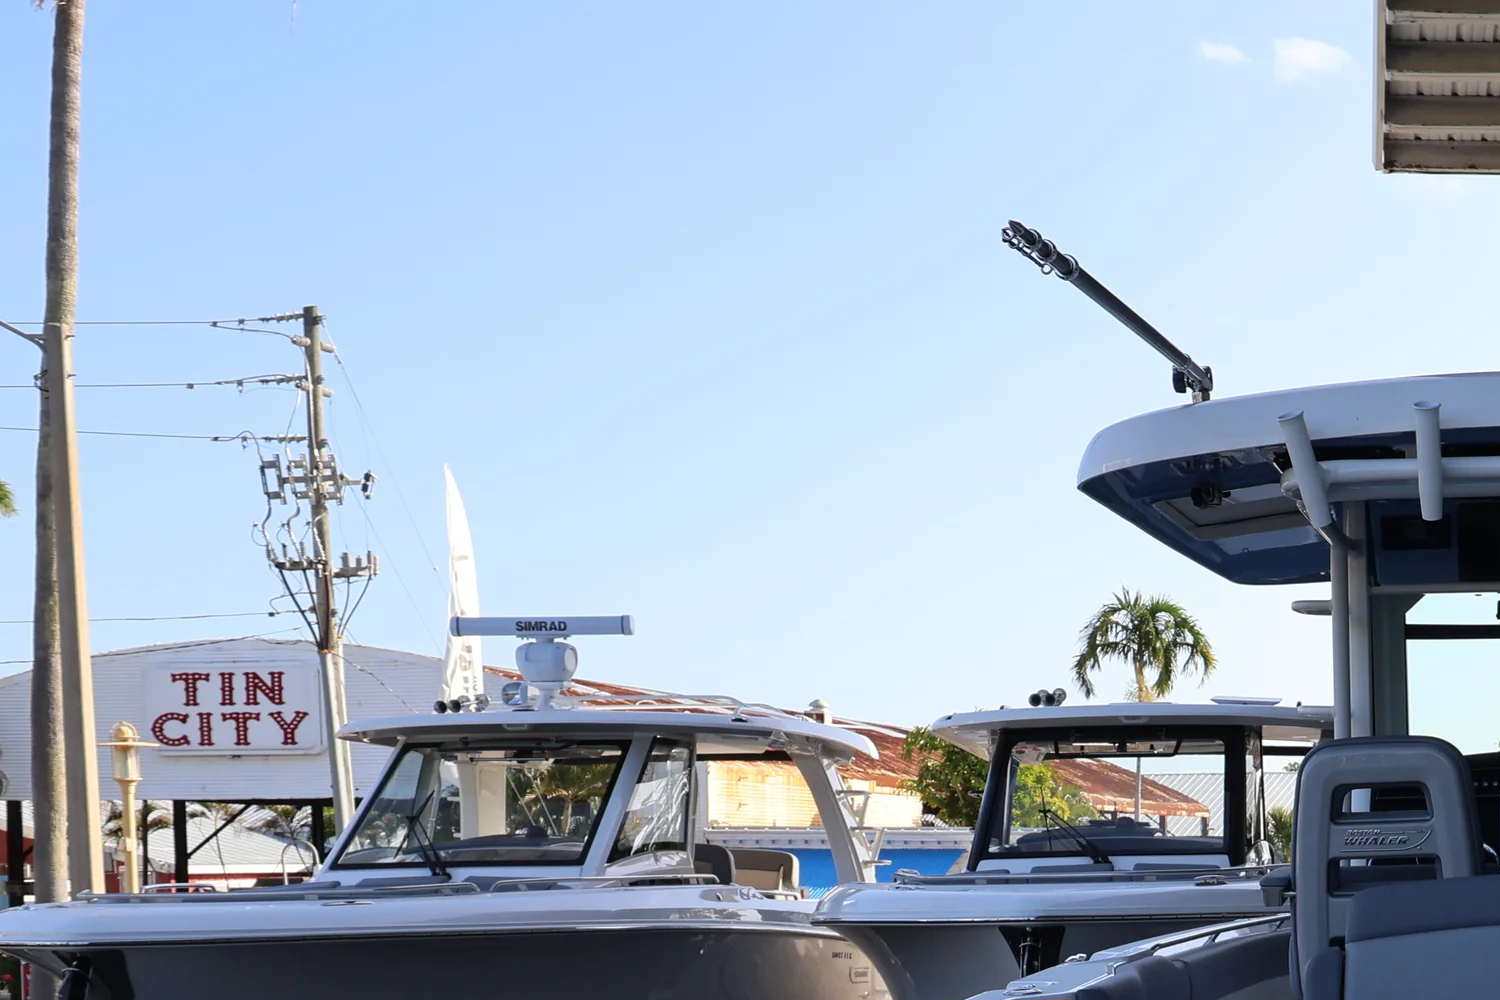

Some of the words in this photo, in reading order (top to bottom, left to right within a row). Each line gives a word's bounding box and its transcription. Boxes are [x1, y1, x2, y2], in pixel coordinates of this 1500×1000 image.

[515, 621, 567, 632] SIMRAD
[170, 671, 285, 706] TIN
[151, 711, 309, 746] CITY
[1344, 836, 1409, 846] WHALER
